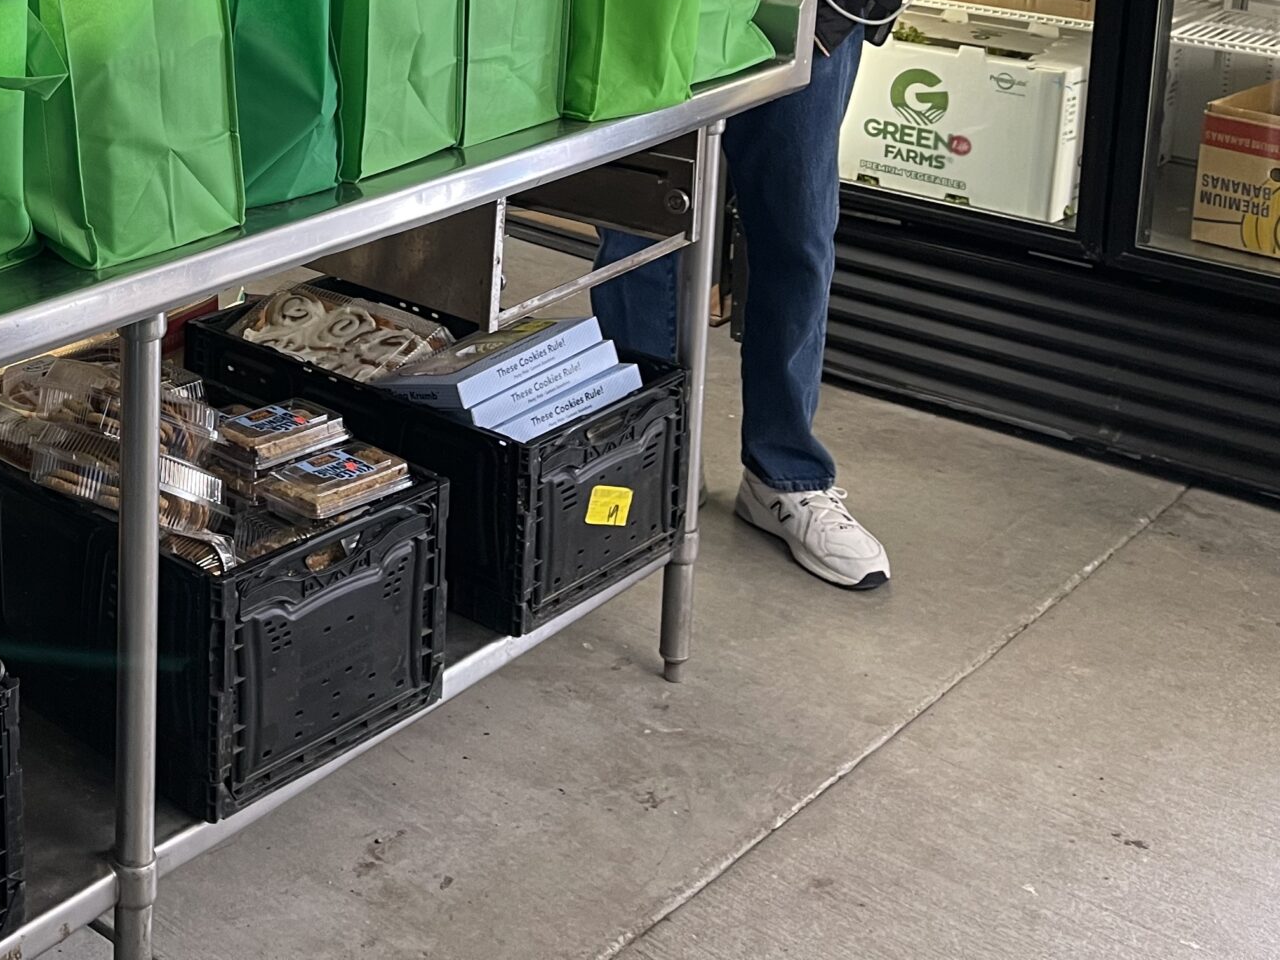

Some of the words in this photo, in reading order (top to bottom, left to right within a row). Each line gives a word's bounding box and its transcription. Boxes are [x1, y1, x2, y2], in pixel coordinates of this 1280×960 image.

[864, 118, 951, 151] GREEN
[884, 144, 946, 170] FARMS
[859, 159, 903, 177] PREMIUM
[904, 168, 967, 191] VEGETABLES
[1202, 173, 1271, 201] BANANAS
[1200, 190, 1270, 218] PREMIUM
[496, 364, 518, 378] These
[518, 349, 548, 367] Cookies
[547, 338, 566, 353] Rule!
[511, 387, 533, 402] These
[533, 373, 562, 391] Cookies
[563, 361, 582, 377] Rule!
[530, 411, 554, 426] These
[554, 397, 584, 415] Cookies
[584, 385, 604, 401] Rule!
